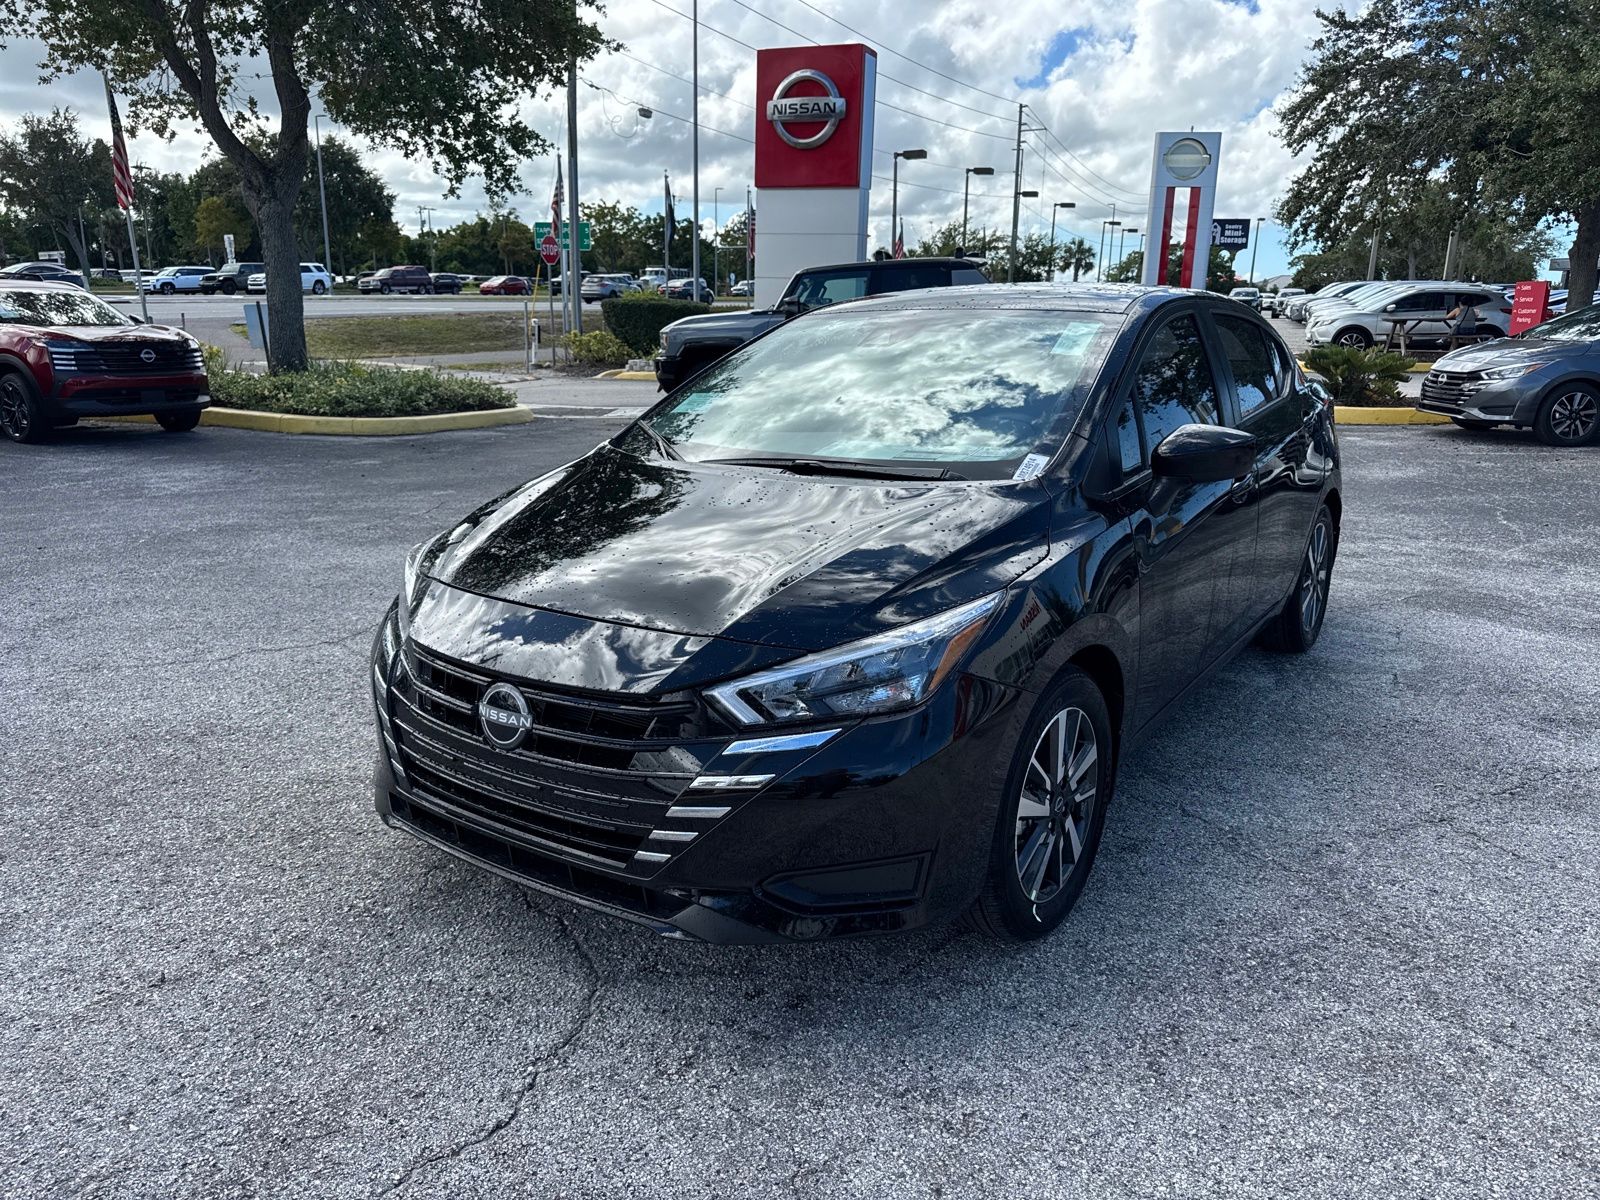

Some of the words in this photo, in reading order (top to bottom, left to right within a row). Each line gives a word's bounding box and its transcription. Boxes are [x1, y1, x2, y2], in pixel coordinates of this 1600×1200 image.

[772, 102, 836, 115] NISSAN
[542, 245, 557, 255] STOP
[479, 703, 531, 728] NISSAN
